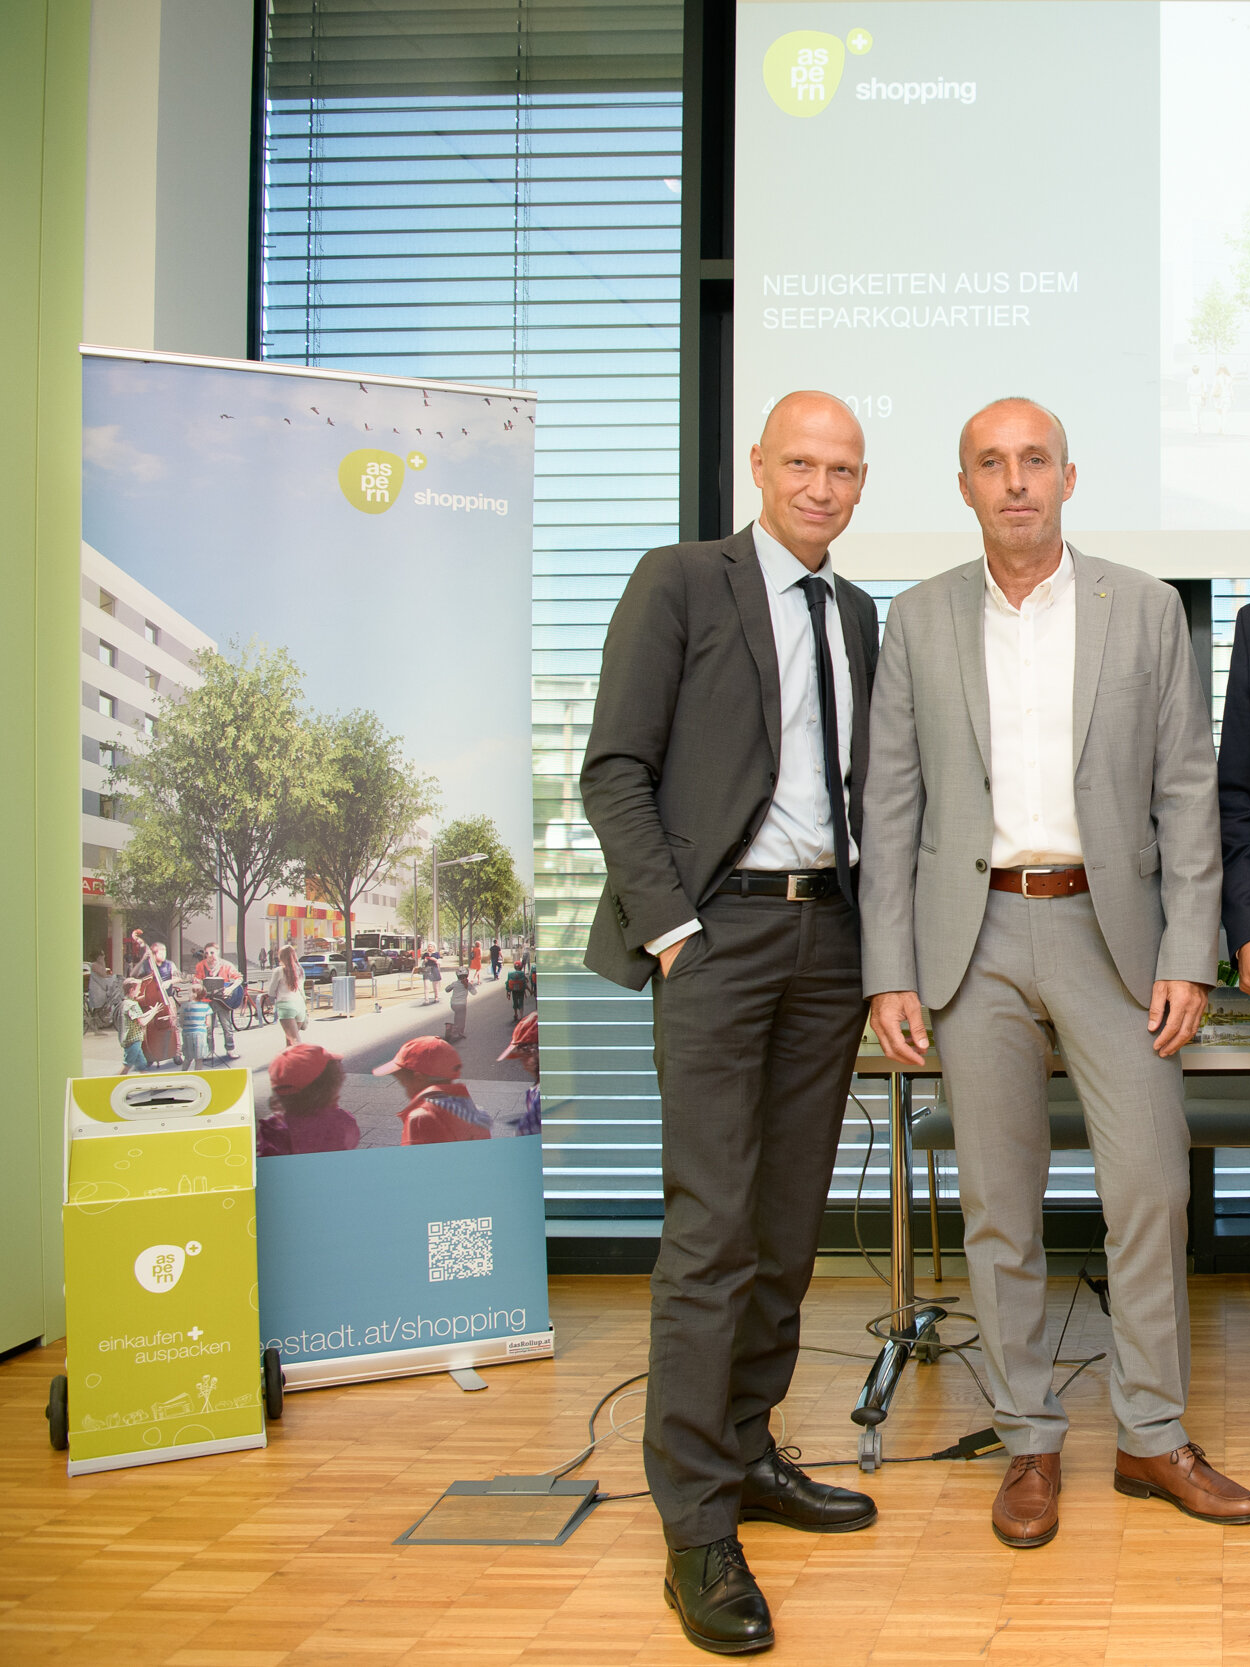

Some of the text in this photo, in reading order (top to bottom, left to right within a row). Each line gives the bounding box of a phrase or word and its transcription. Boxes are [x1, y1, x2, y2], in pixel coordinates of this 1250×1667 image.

[797, 48, 829, 66] as
[791, 65, 825, 89] pe
[855, 76, 977, 104] shopping
[763, 271, 1079, 297] NEUIGKEITEN AUS DEM
[762, 305, 1032, 330] SEEPARKQUARTIER
[366, 461, 393, 477] as
[361, 474, 390, 492] pe
[414, 488, 509, 517] shopping
[98, 1330, 184, 1353] einkaufen
[135, 1340, 231, 1364] auspacken
